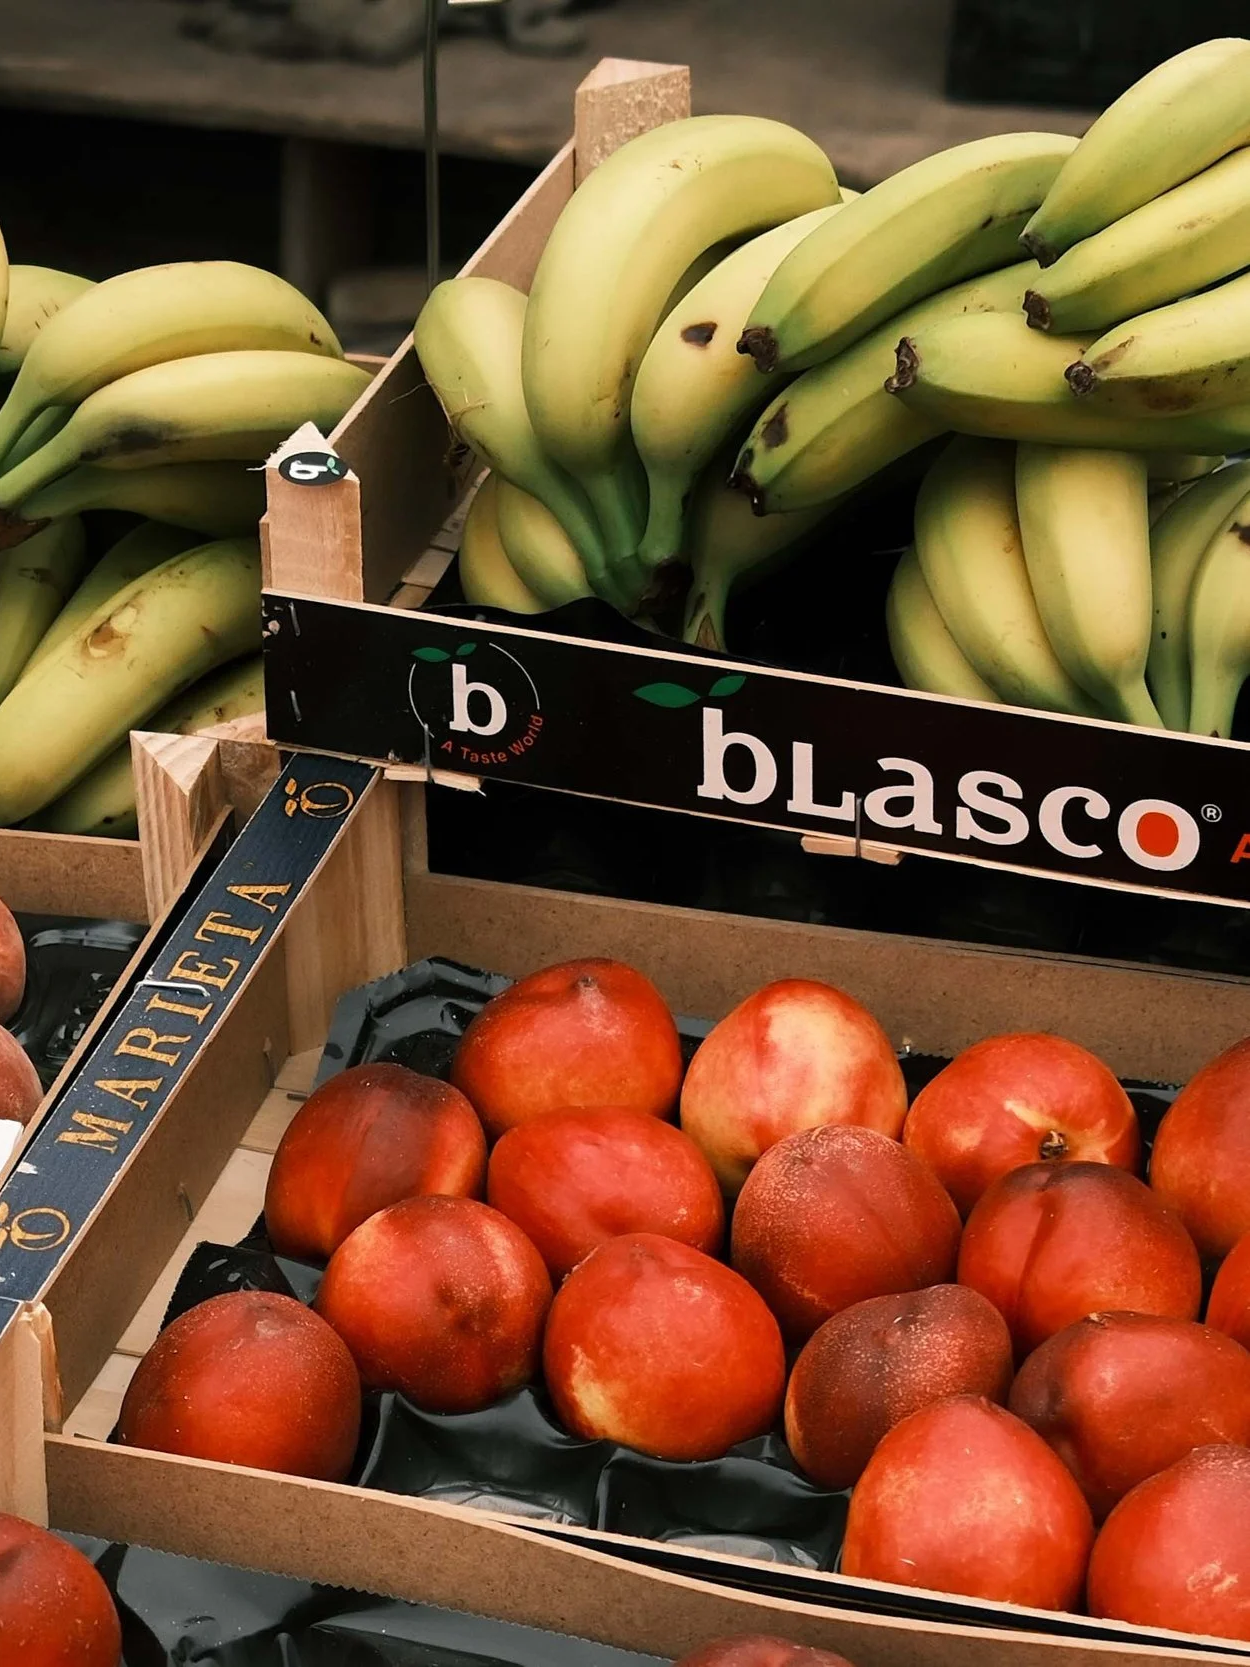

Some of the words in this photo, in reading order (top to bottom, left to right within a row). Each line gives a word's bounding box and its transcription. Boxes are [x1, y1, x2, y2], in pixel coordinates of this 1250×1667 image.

[449, 663, 508, 736] b
[460, 746, 508, 765] Taste
[508, 713, 544, 756] World
[54, 882, 293, 1154] MARIETA
